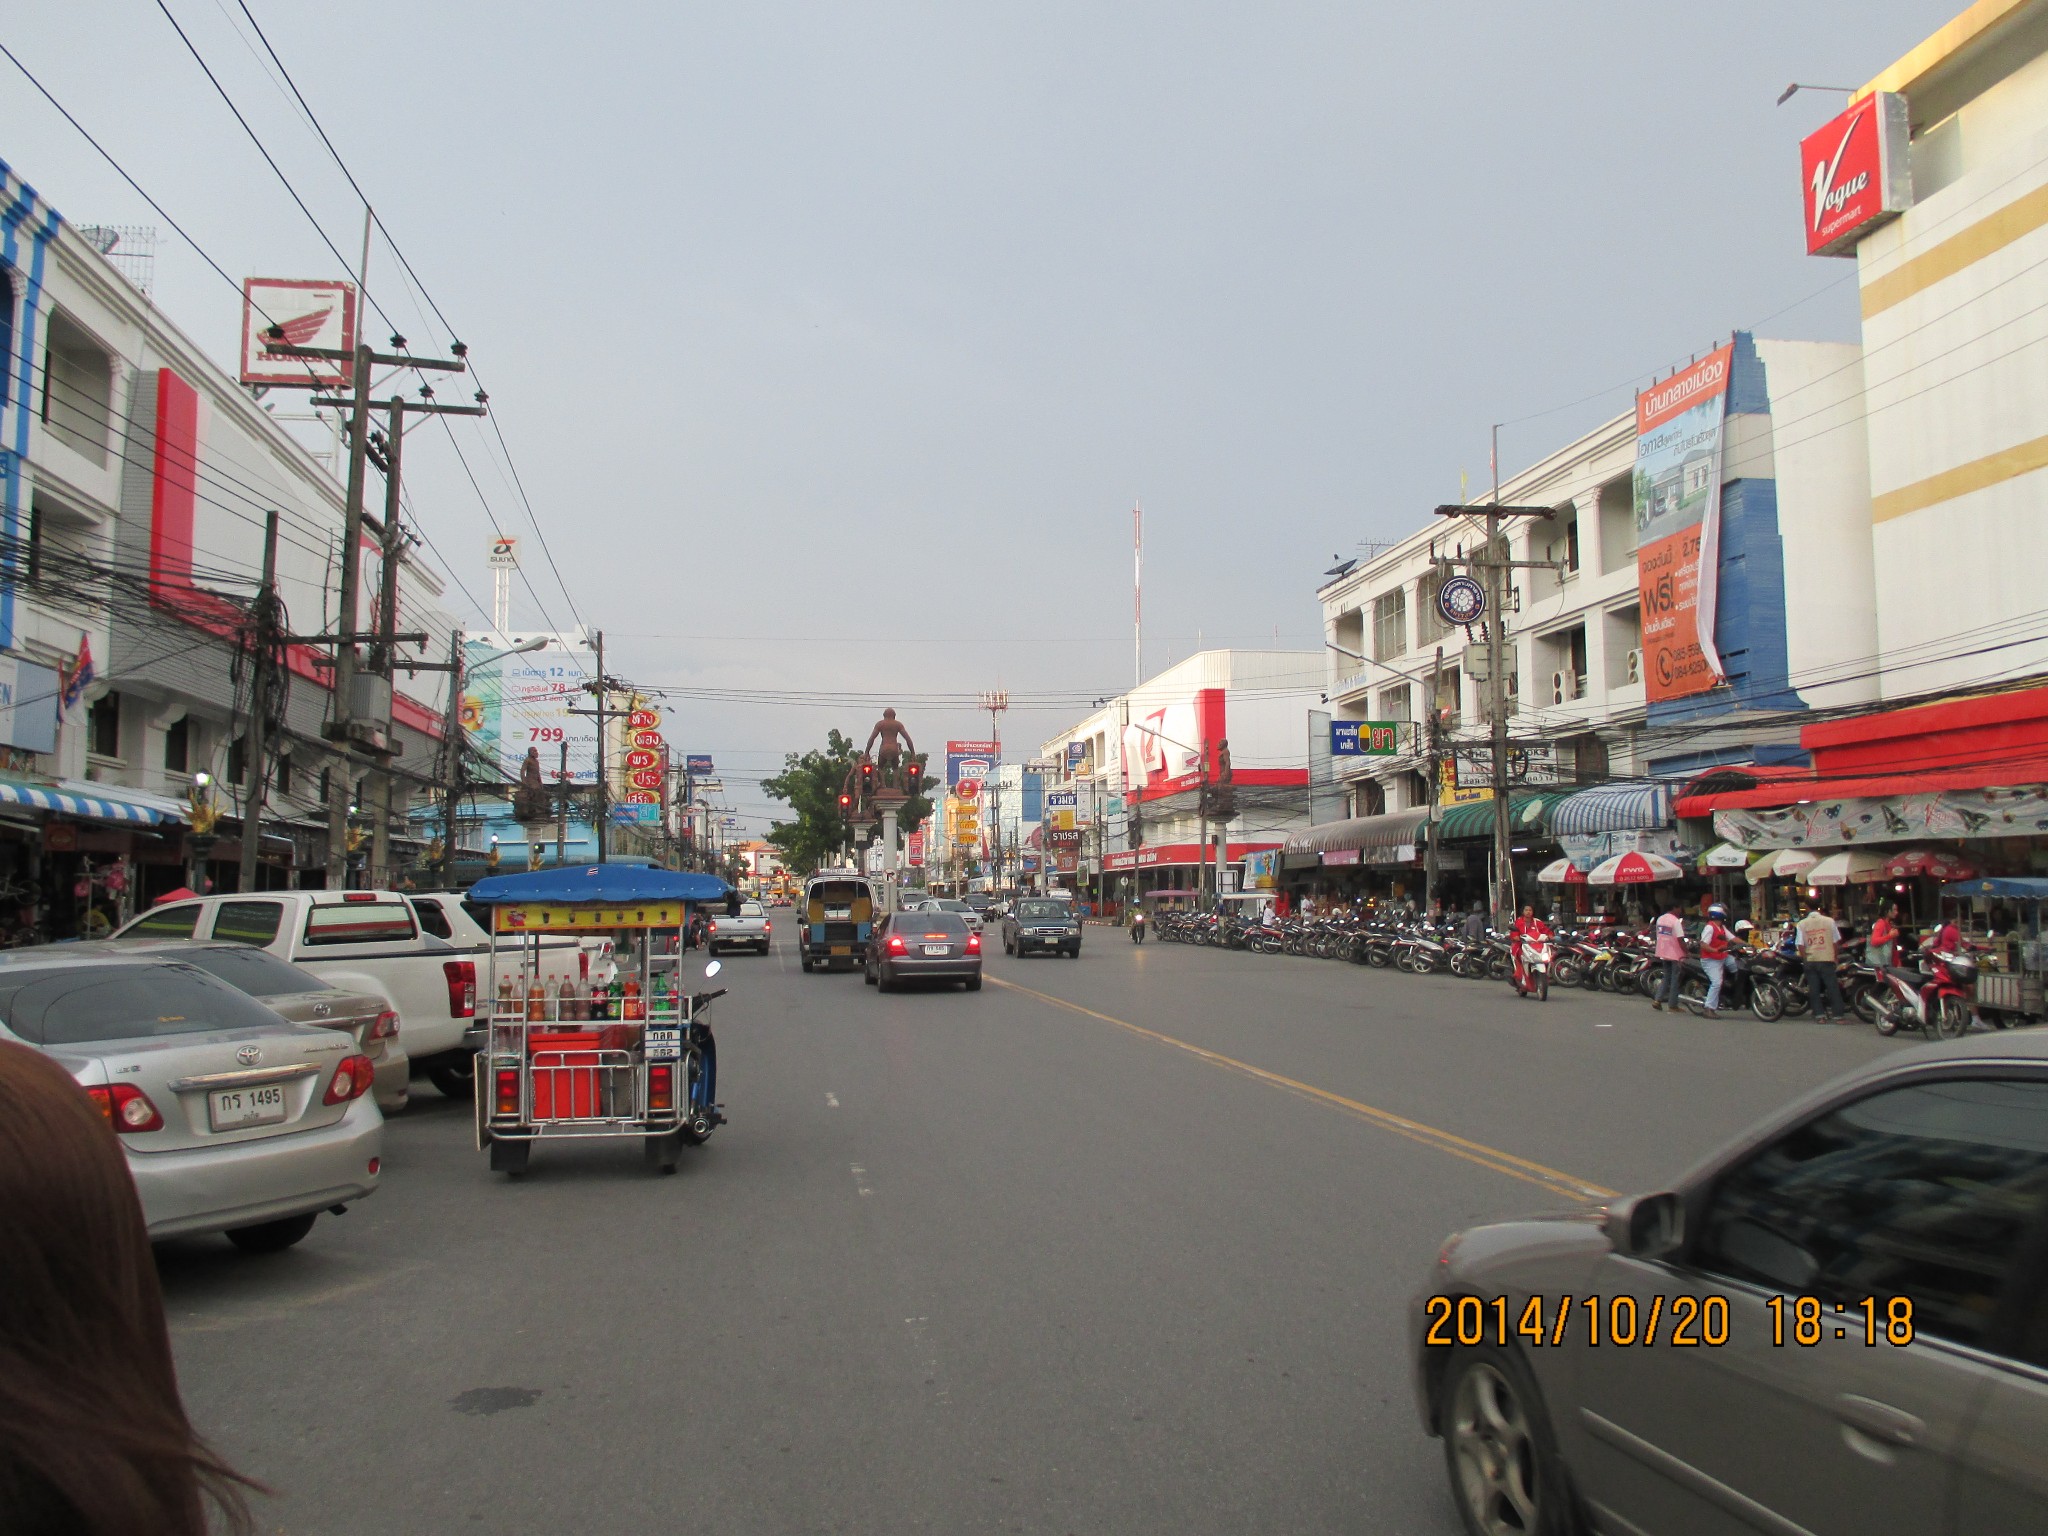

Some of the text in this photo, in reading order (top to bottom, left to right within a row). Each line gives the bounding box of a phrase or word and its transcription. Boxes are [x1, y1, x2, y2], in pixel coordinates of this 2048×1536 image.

[1811, 111, 1868, 233] Vogue
[1821, 205, 1862, 237] supermart
[1645, 361, 1723, 417] บ้านกลางเมือง
[1643, 572, 1674, 617] ฟรี!
[550, 667, 564, 677] 12
[551, 682, 565, 693] 78
[631, 711, 654, 723] ห้าง
[529, 727, 564, 742] 799
[637, 735, 660, 745] ทอง
[1372, 727, 1394, 750] ยา
[632, 755, 649, 765] พร
[637, 774, 658, 785] ประ
[1052, 831, 1079, 841] ราชรส
[222, 1088, 280, 1111] กร 1495
